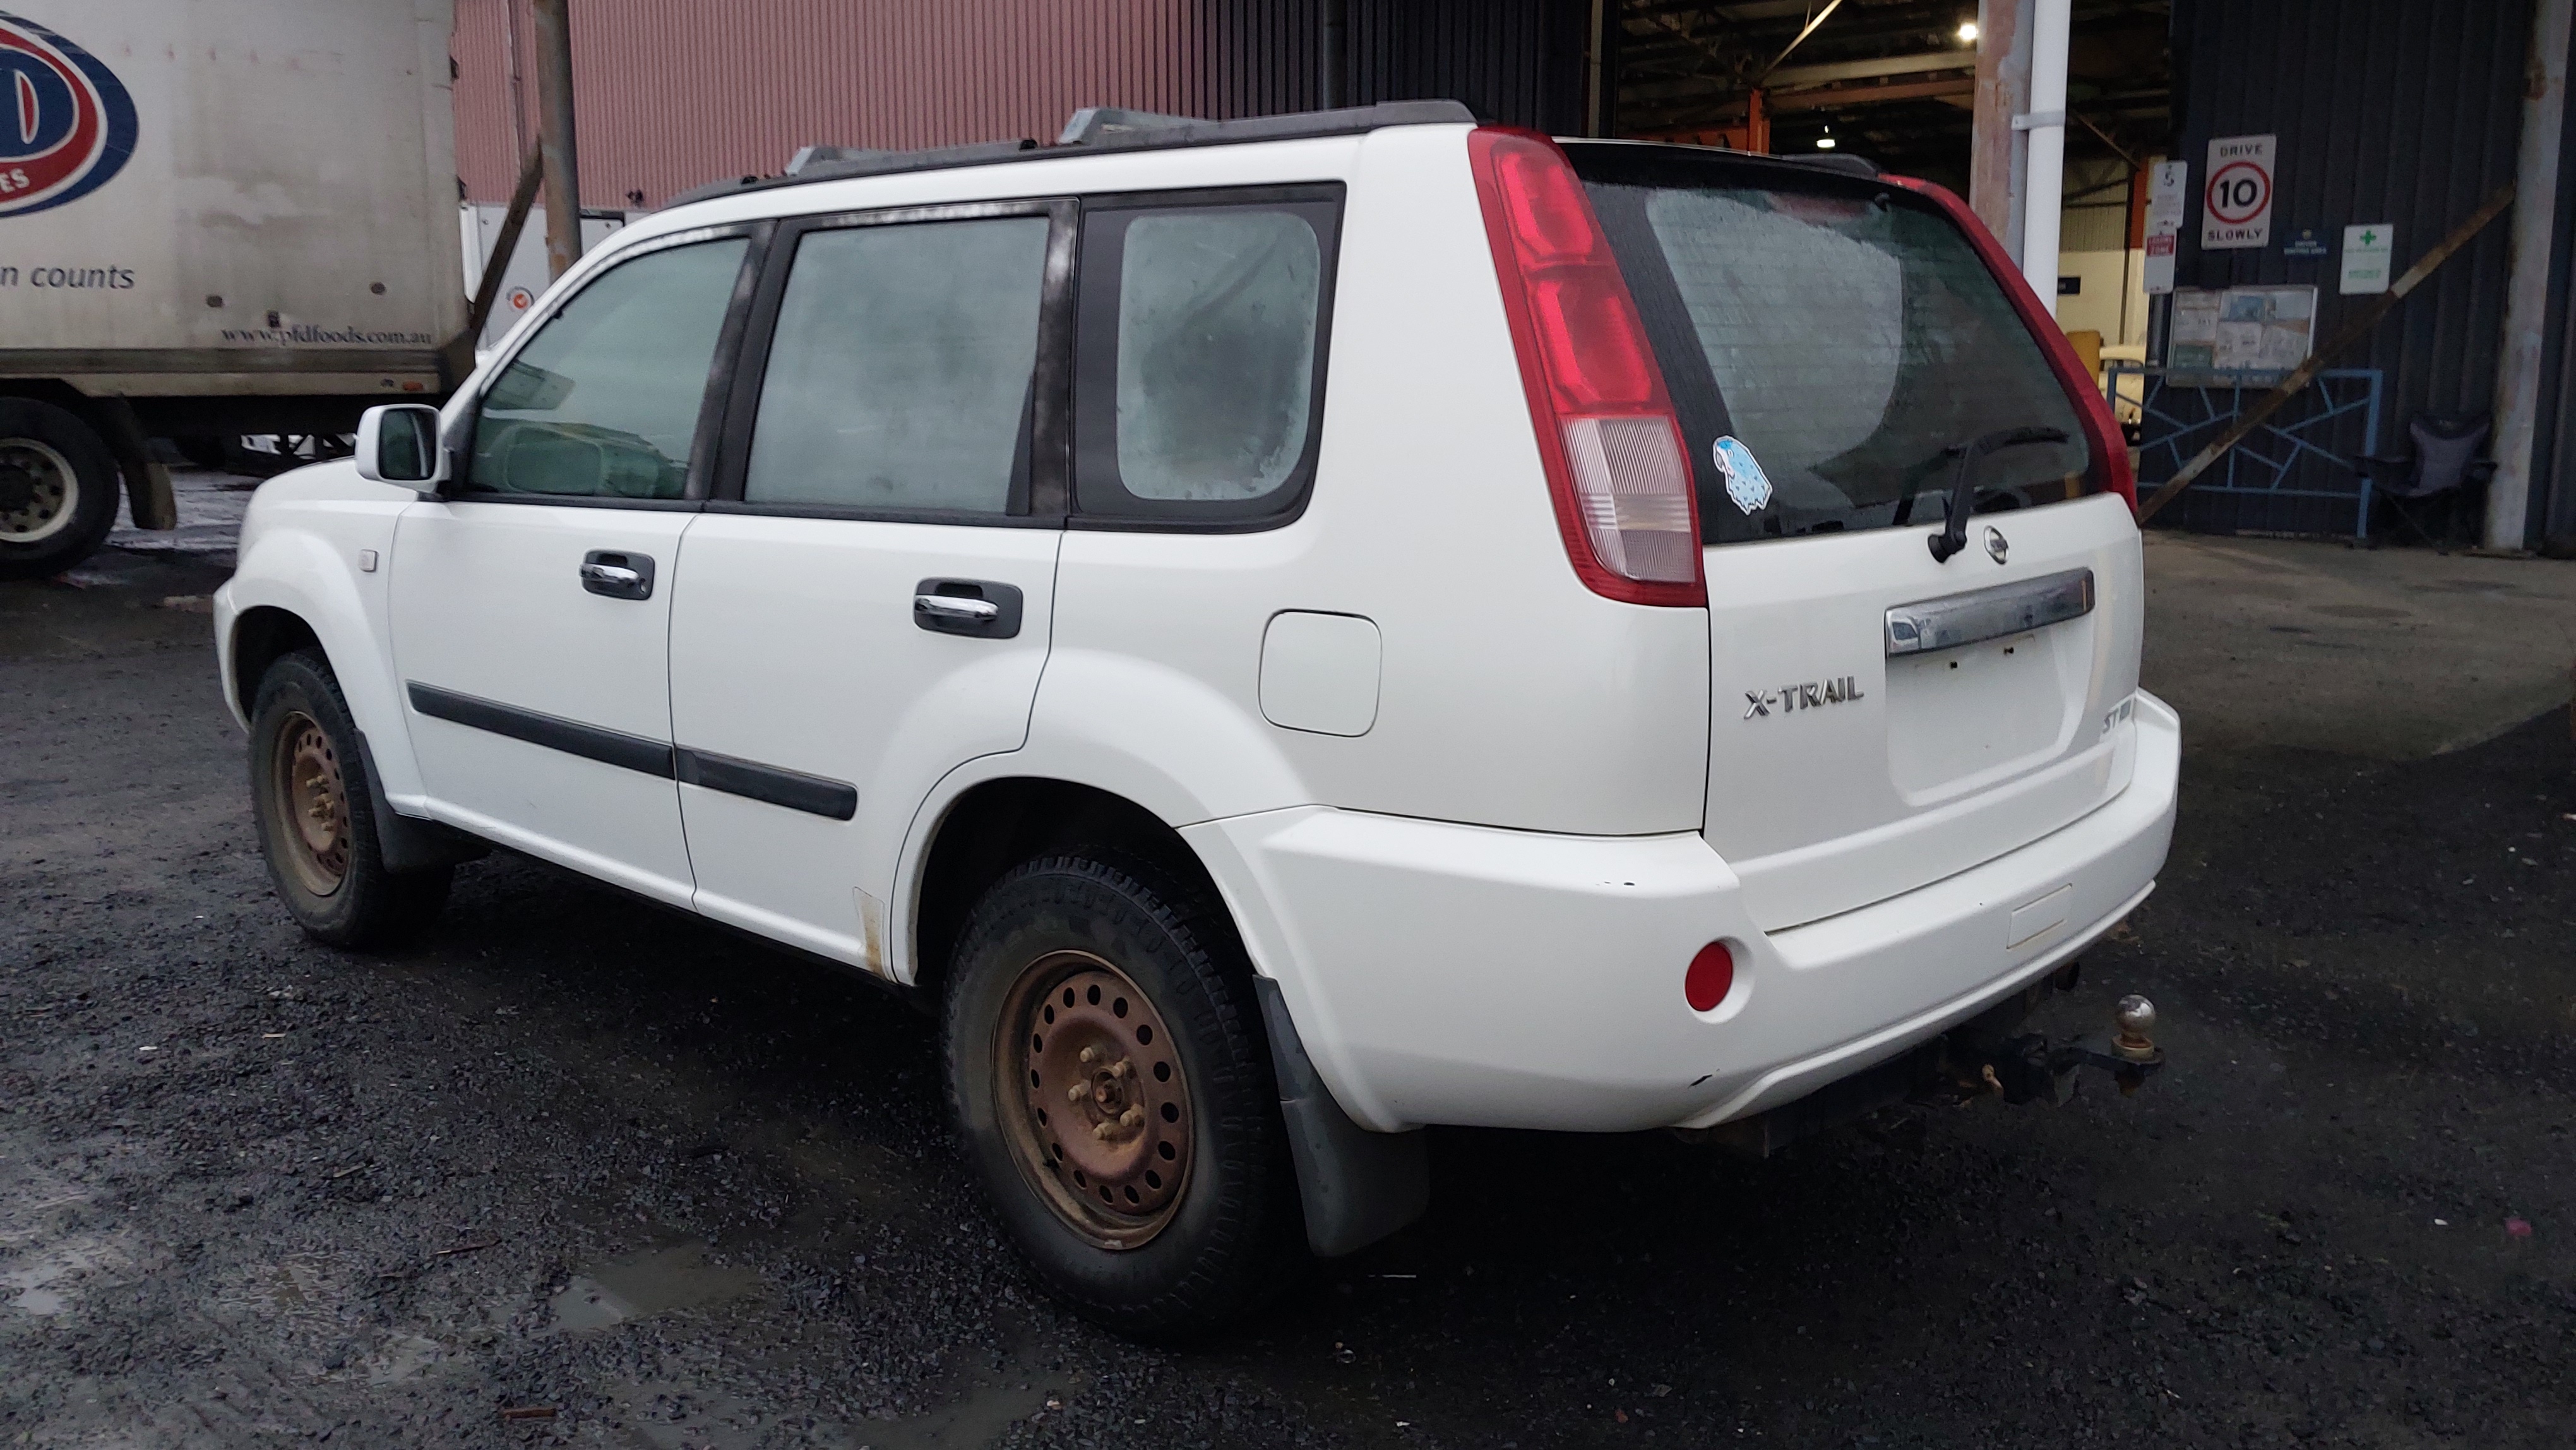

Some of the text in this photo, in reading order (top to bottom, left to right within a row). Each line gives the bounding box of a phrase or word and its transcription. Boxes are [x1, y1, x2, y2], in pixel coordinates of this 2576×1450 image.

[2220, 145, 2263, 157] DRIVE
[2220, 179, 2257, 208] 10
[2208, 227, 2263, 241] SLOWLY
[30, 264, 134, 289] counts
[221, 323, 432, 345] www.pfdfoods.com.au
[1743, 675, 1864, 720] X-TRAIL
